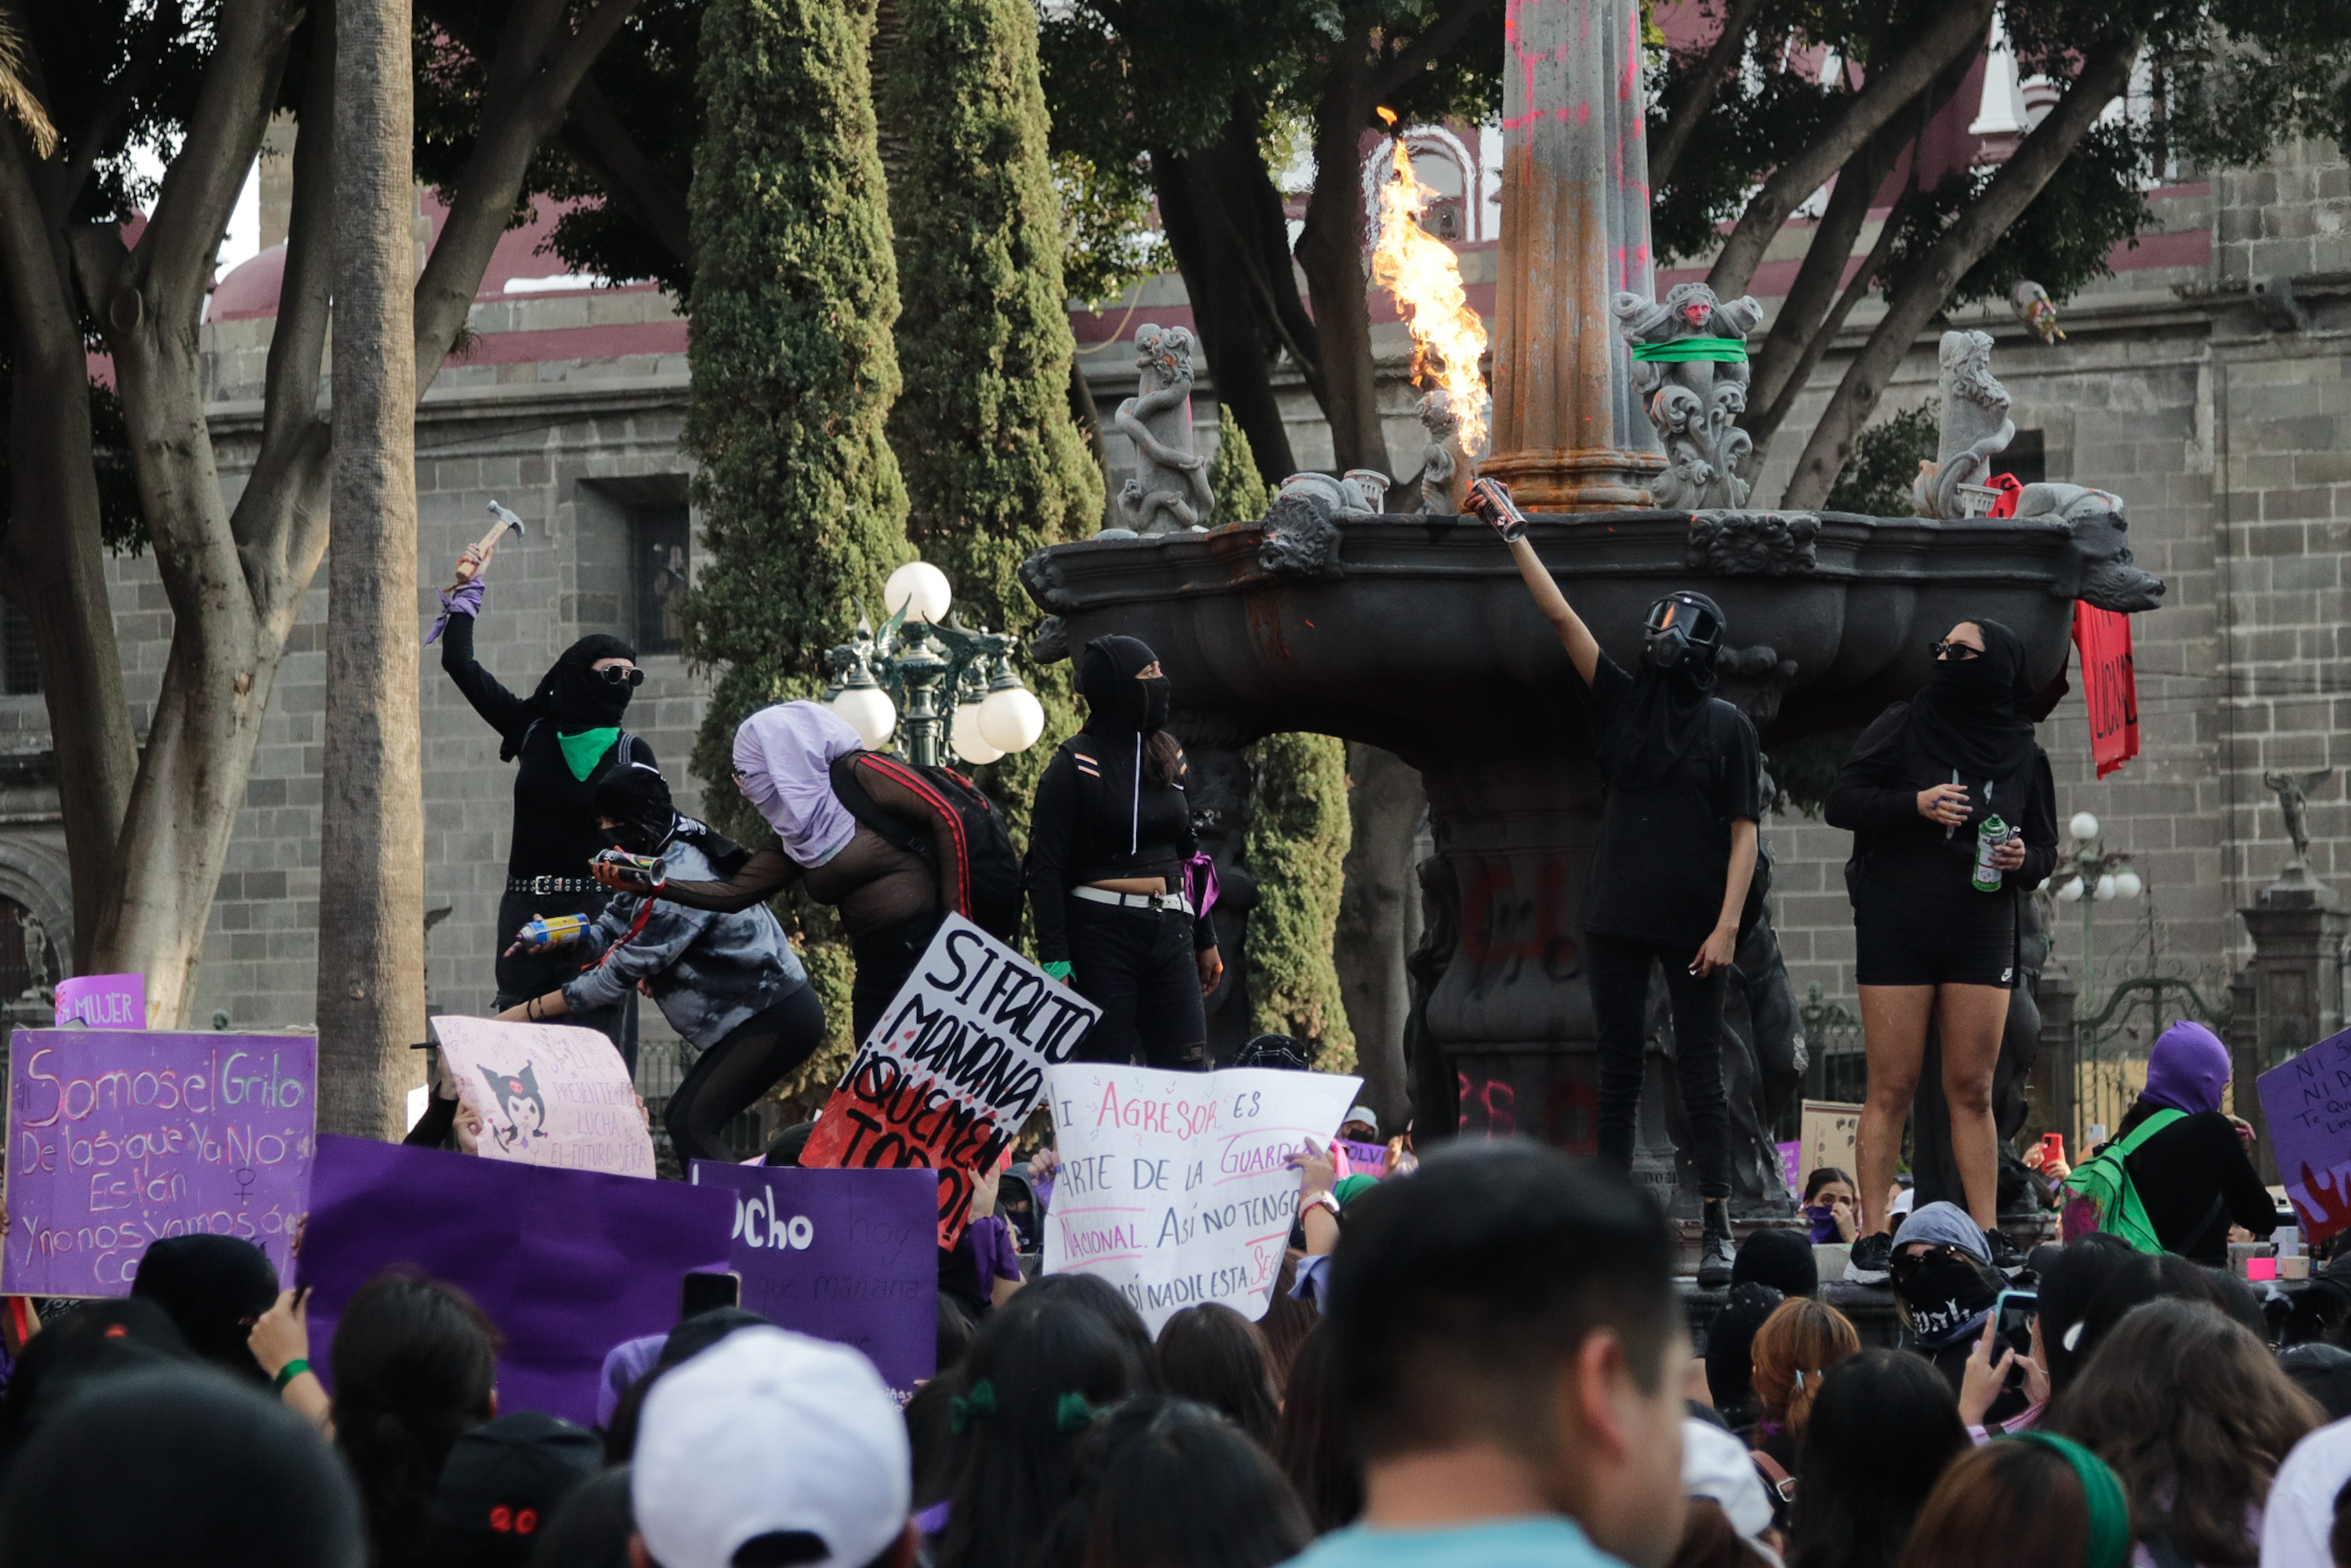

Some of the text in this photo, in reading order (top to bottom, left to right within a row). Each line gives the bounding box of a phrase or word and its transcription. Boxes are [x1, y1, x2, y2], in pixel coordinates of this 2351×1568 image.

[925, 929, 999, 1005] SI
[75, 992, 133, 1024] MUJER
[22, 1048, 179, 1128] Somos
[223, 1051, 305, 1109] Grito
[552, 1081, 618, 1106] PRESENTE
[577, 1110, 621, 1137] LUCHA
[1097, 1081, 1218, 1141] AGRESOR
[1233, 1092, 1262, 1118] ES
[22, 1131, 56, 1174] De
[65, 1124, 120, 1174] las
[125, 1128, 185, 1177] que
[550, 1137, 649, 1172] EL FUTURO SERÁ
[1133, 1158, 1171, 1192] DE
[1185, 1161, 1203, 1193] LA
[1202, 1204, 1237, 1234] NO
[78, 1222, 146, 1253] nos
[1147, 1274, 1204, 1311] NADIE
[1211, 1266, 1248, 1298] ESTA
